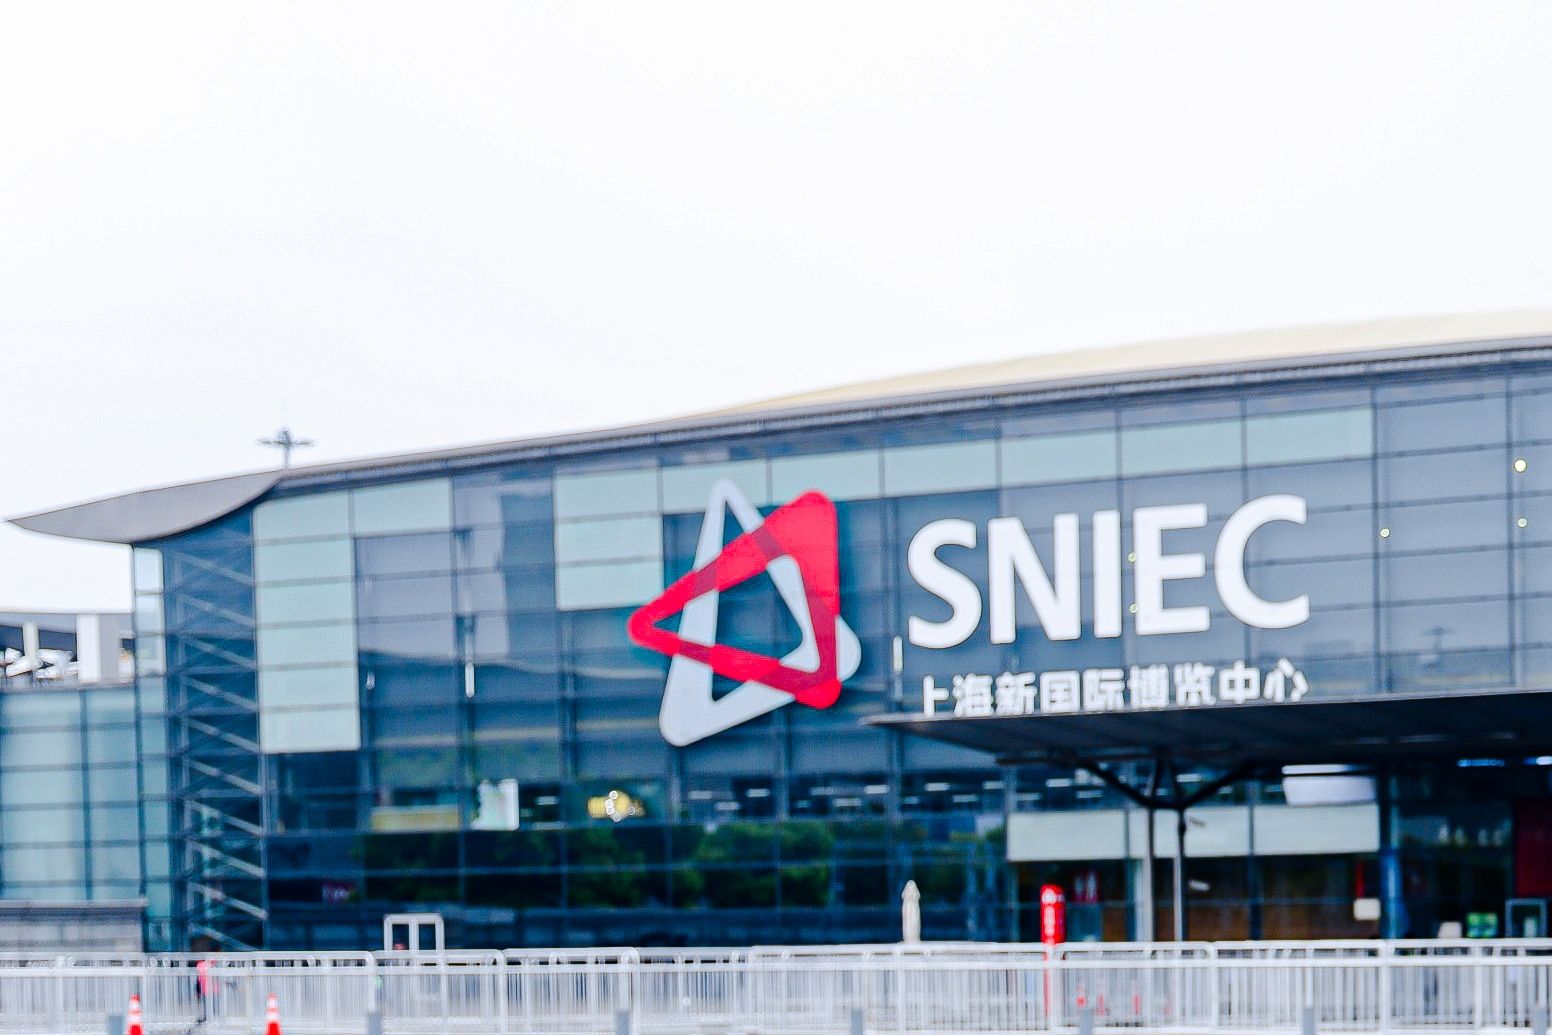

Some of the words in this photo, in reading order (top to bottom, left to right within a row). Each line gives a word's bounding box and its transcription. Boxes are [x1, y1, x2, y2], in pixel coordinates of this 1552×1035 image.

[907, 493, 1310, 649] SNIEC
[923, 657, 1310, 717] 上海新国际博览中心
